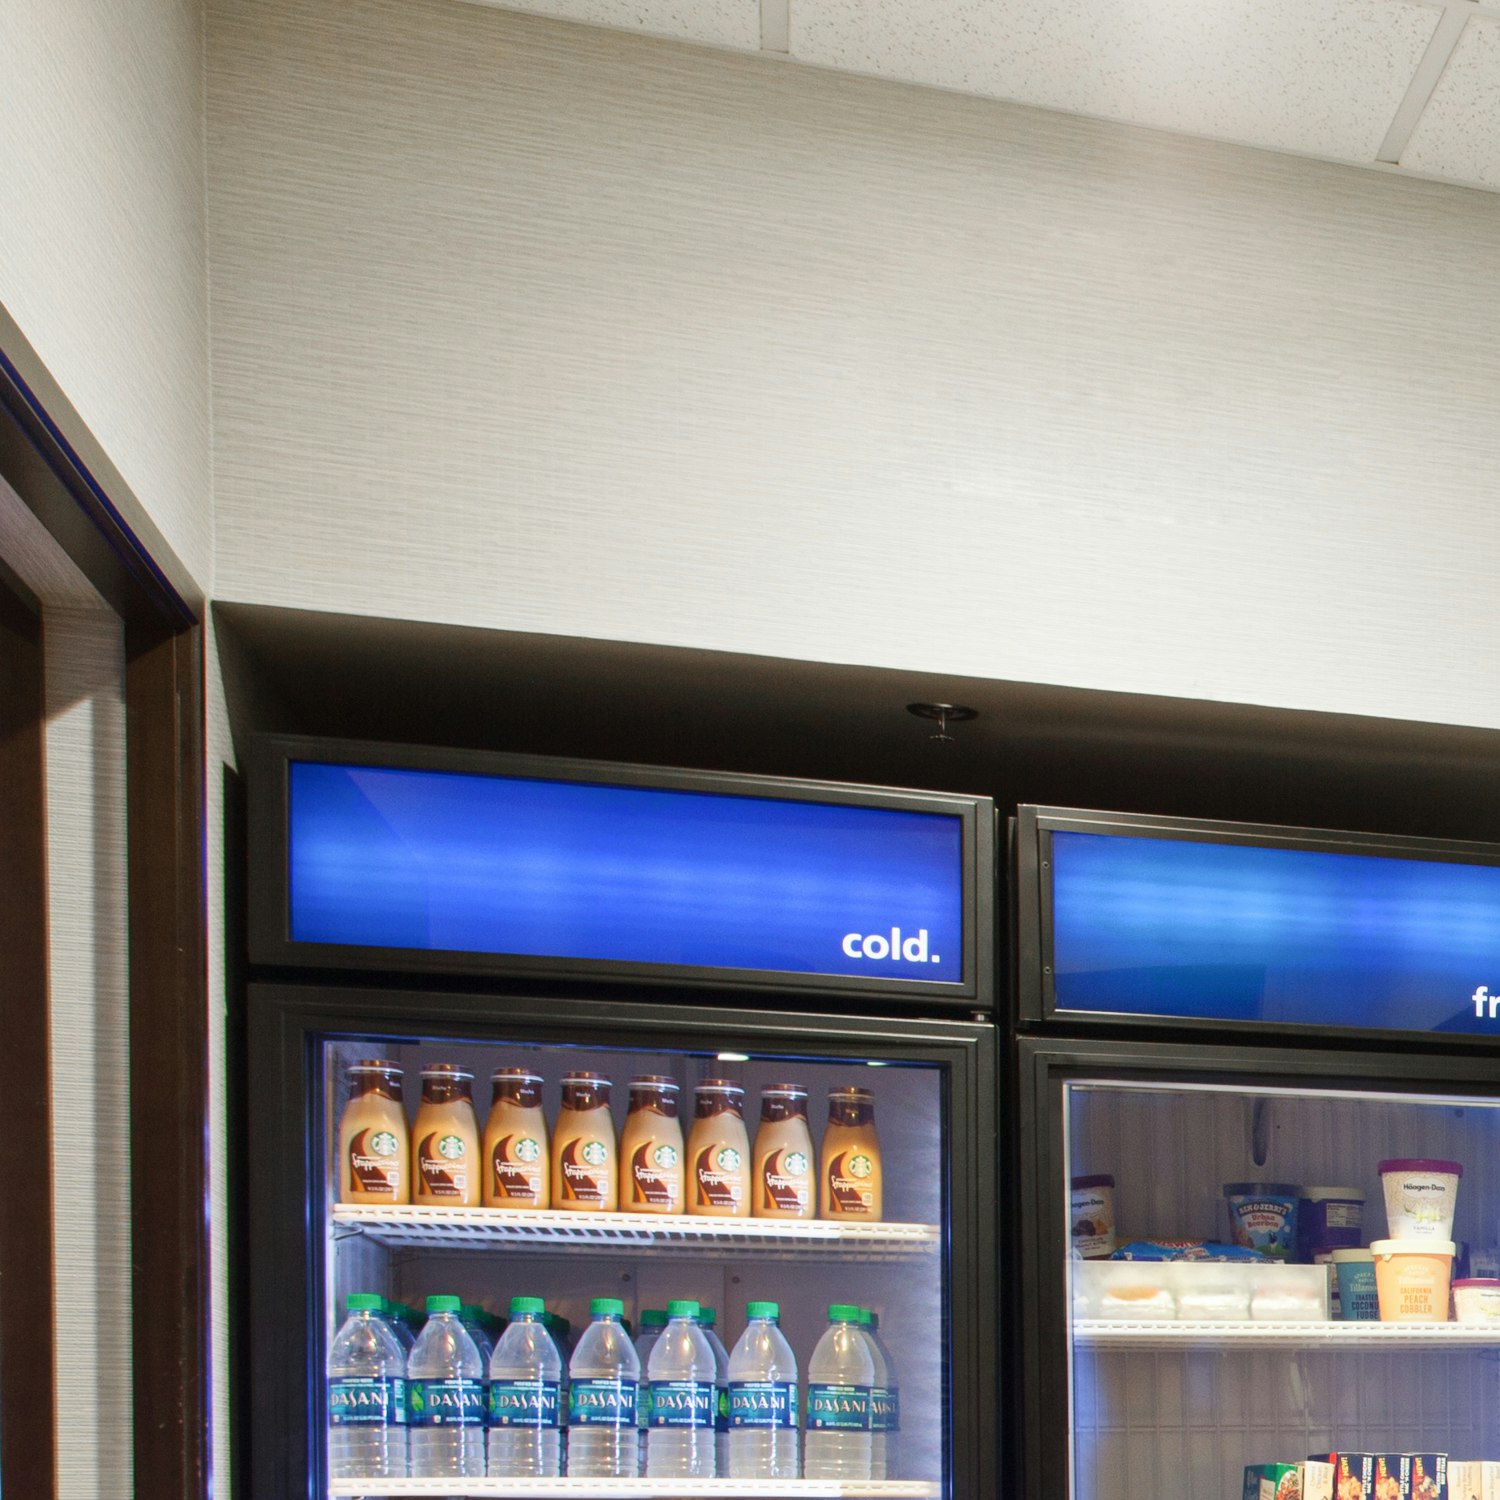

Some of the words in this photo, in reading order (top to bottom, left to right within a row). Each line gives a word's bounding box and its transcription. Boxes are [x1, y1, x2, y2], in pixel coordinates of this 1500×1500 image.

[842, 928, 940, 964] cold.
[1404, 1295, 1428, 1303] PEACH
[1400, 1305, 1432, 1314] COBBLER
[331, 1390, 389, 1408] DASANI
[430, 1392, 482, 1408] DASANI
[500, 1392, 555, 1410] DASANI
[578, 1393, 633, 1411] DASANI
[656, 1391, 709, 1410] DASANI
[733, 1393, 785, 1410] DASANI
[814, 1396, 866, 1413] DASANI
